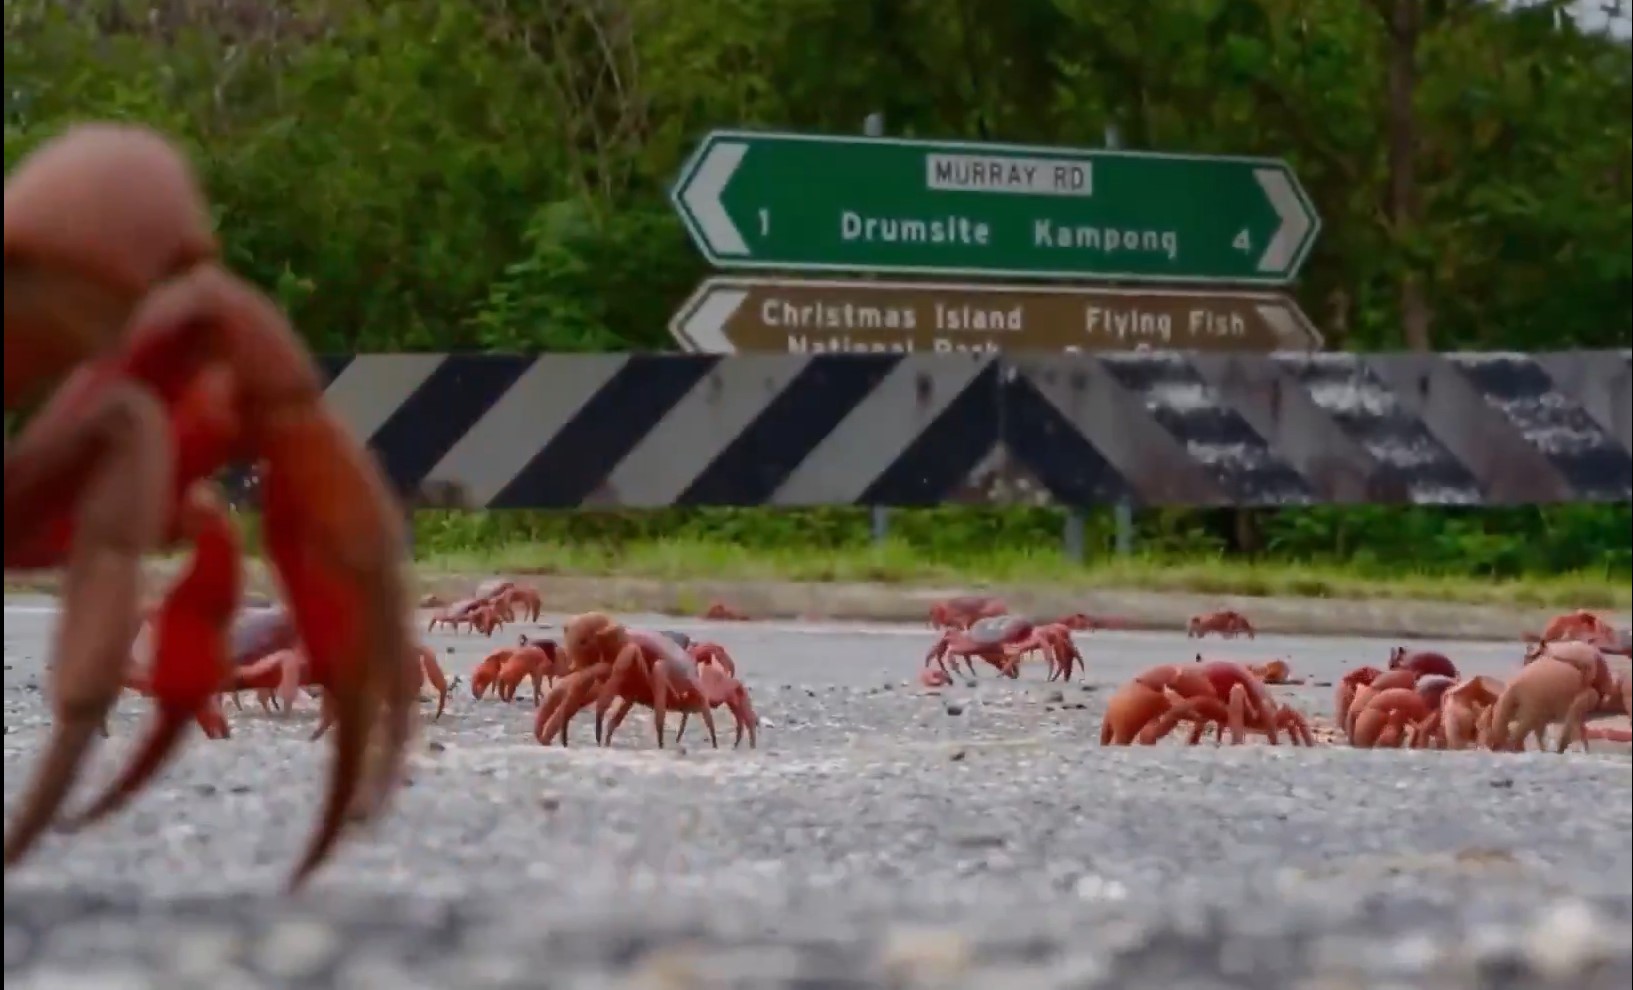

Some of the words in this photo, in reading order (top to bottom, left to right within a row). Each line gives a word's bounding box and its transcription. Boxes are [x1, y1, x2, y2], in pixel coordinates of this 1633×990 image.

[935, 160, 1037, 186] MURRAY
[1053, 166, 1085, 190] RD
[758, 207, 770, 237] 1
[841, 211, 989, 245] Drumsite
[1034, 219, 1177, 259] Kampong
[1232, 227, 1250, 254] 4
[763, 299, 916, 329] Christmas
[935, 303, 1022, 331] Island
[1086, 306, 1171, 343] Flying
[1188, 310, 1245, 336] Fish
